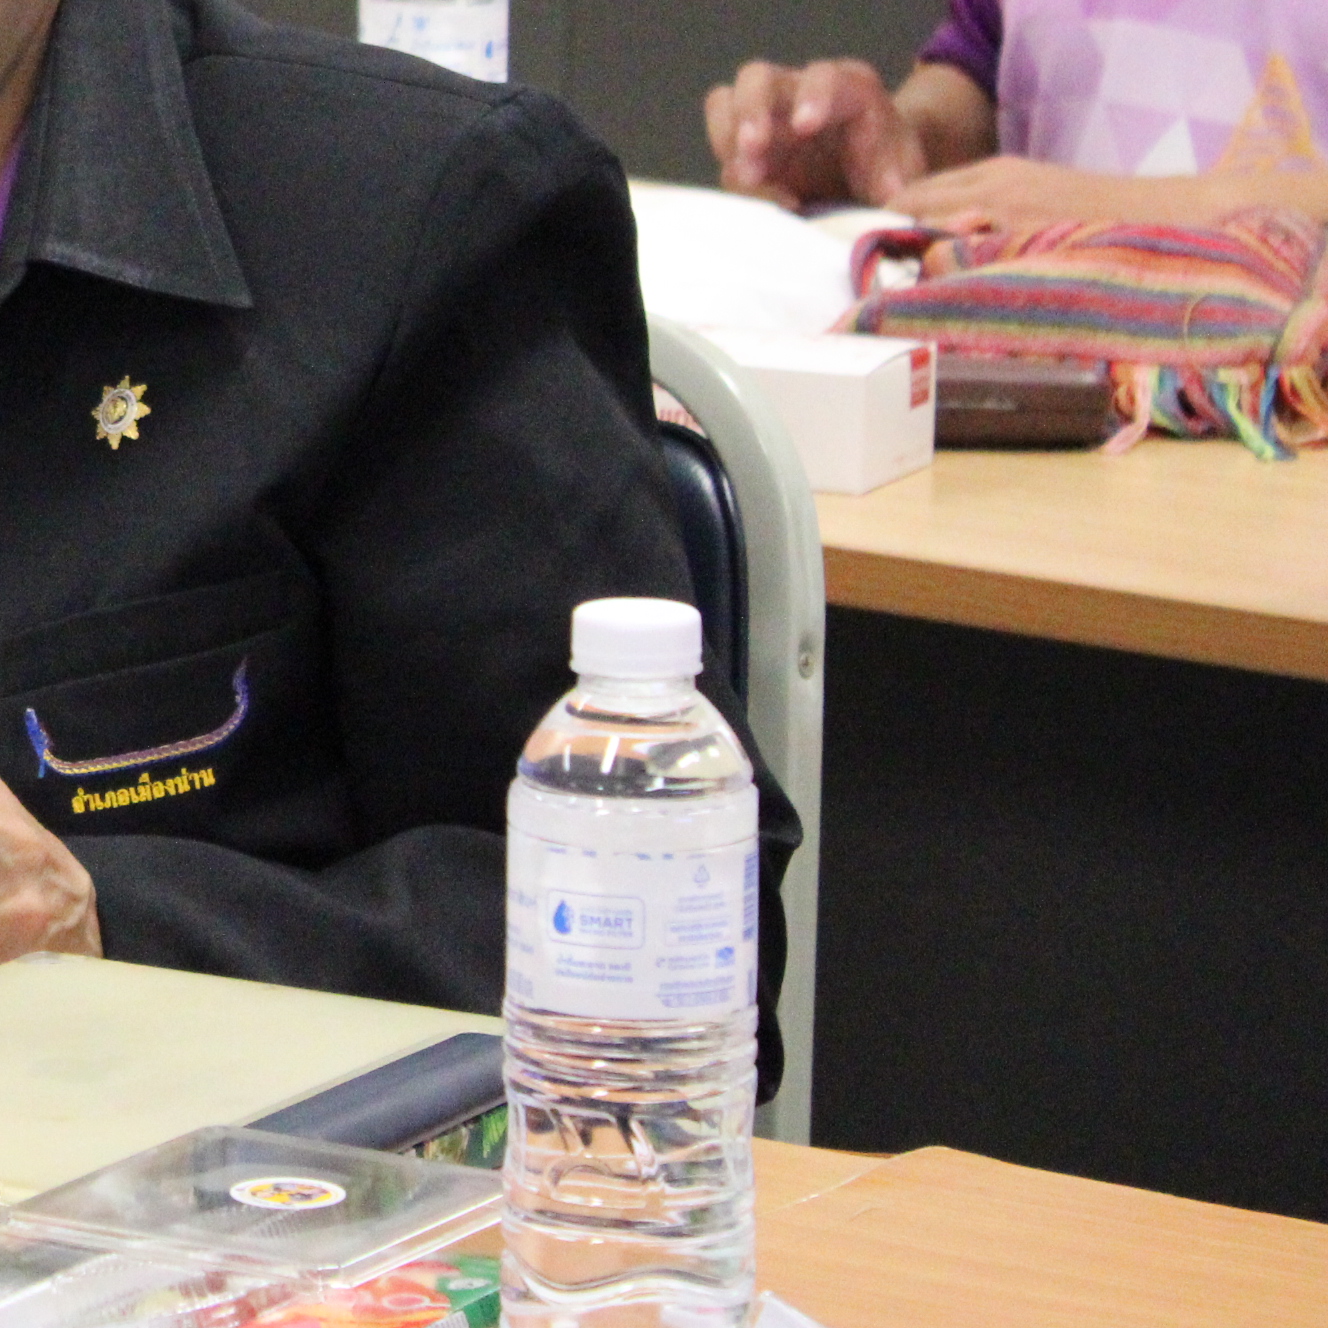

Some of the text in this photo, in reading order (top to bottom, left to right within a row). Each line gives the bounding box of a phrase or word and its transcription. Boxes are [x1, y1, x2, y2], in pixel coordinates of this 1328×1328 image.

[71, 767, 216, 814] อำเภอเมืองน่าน
